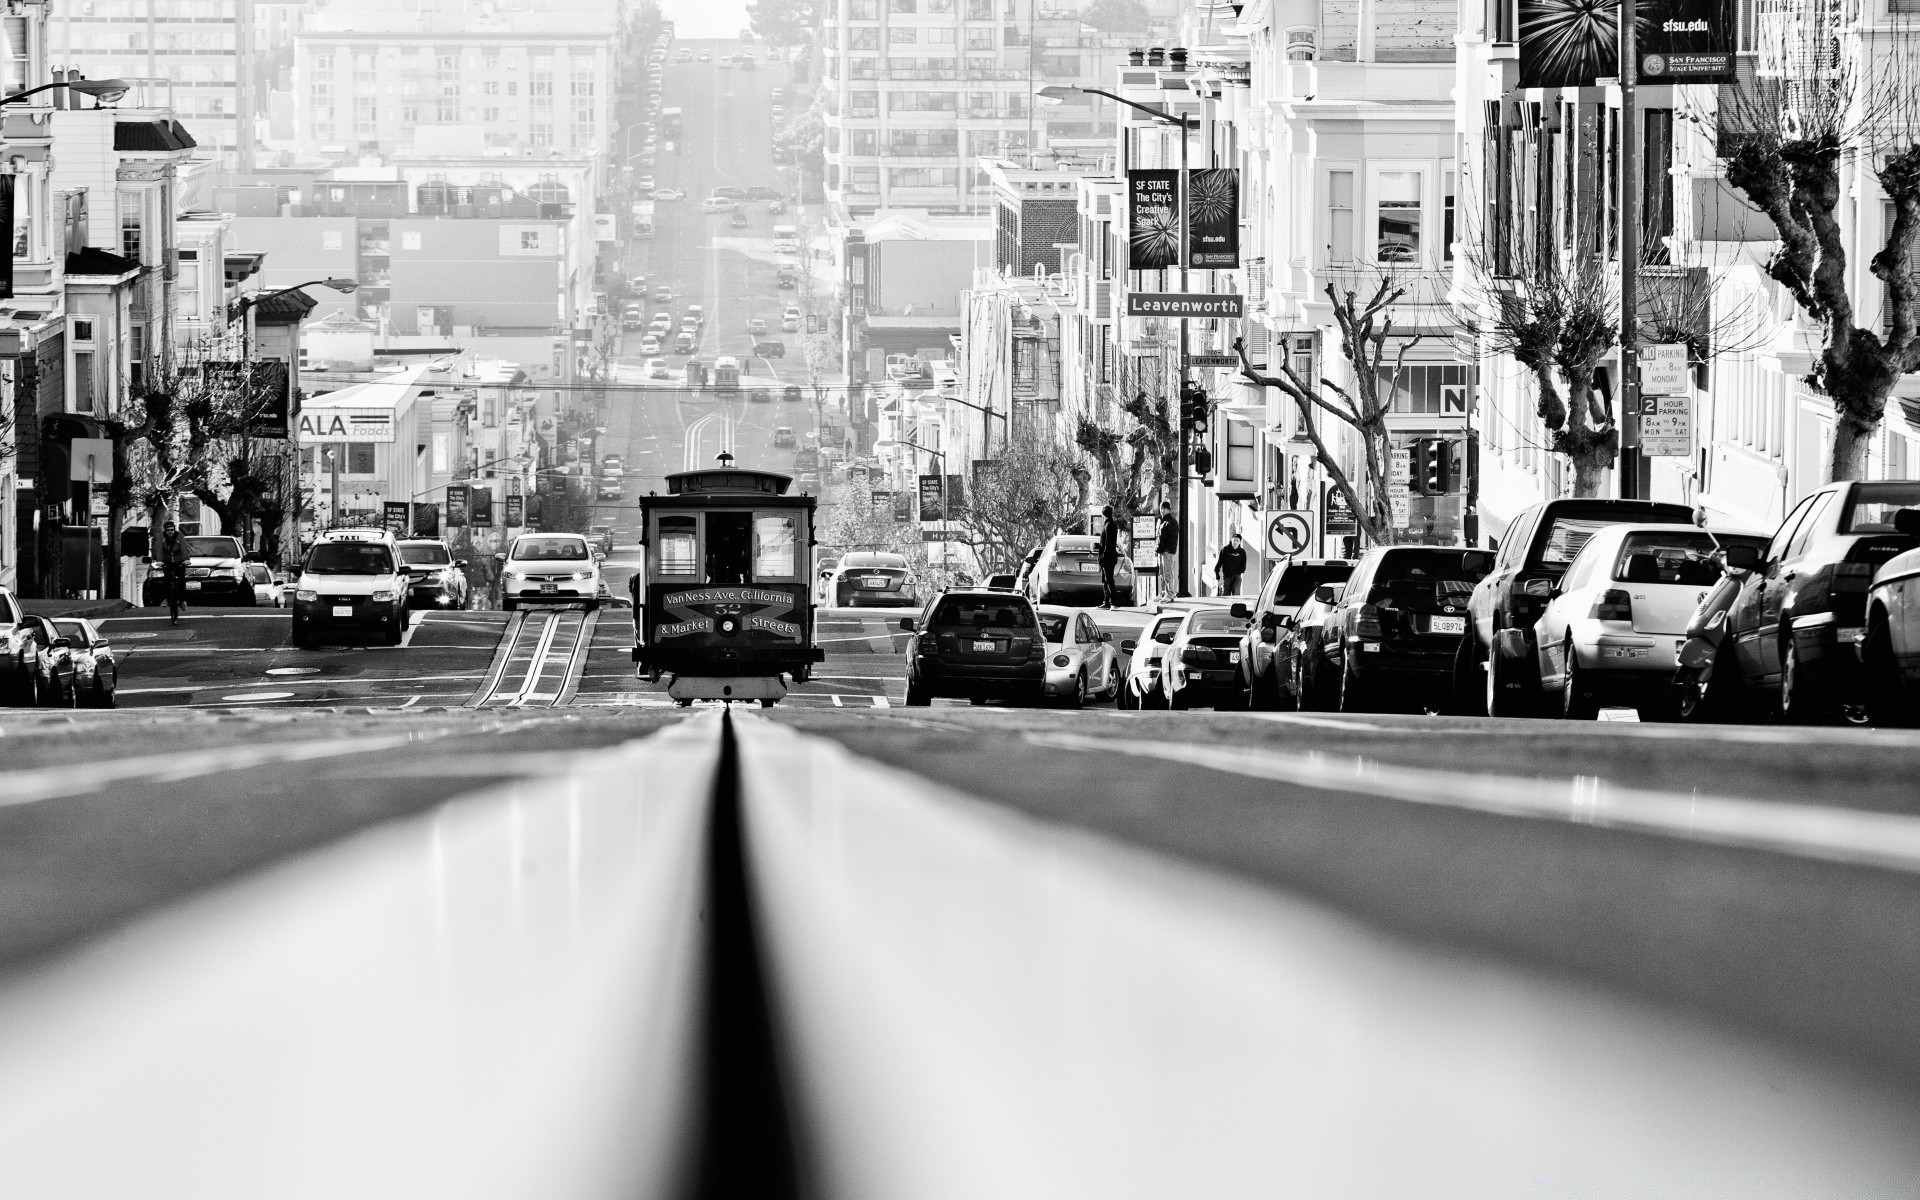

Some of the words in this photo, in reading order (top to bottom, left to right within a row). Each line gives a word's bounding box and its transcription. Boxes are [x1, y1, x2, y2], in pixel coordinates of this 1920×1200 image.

[1662, 18, 1708, 32] sfsu.edu
[1669, 56, 1684, 64] SAN
[1135, 180, 1146, 190] SF
[1147, 180, 1170, 190] STATE
[1136, 192, 1150, 202] The
[1151, 192, 1172, 203] City's
[1136, 204, 1169, 214] Creative
[1202, 235, 1226, 243] sfsu.edu
[1132, 298, 1238, 313] Leavenworth
[1643, 346, 1655, 360] NO
[1657, 349, 1685, 359] PARKING
[1192, 357, 1237, 365] LEAVENWORTH
[1651, 375, 1678, 383] MONDAY
[1644, 399, 1655, 412] 2
[1663, 400, 1684, 408] HOUR
[1658, 408, 1689, 416] PARKING
[300, 415, 347, 436] ALA
[353, 424, 390, 436] Foods
[1644, 428, 1660, 436] MON
[1674, 428, 1688, 436] SAT
[666, 594, 685, 605] Van
[685, 592, 711, 602] Ness
[740, 590, 793, 604] California
[714, 603, 741, 615] 52
[661, 624, 669, 635] &
[670, 619, 709, 634] Market
[751, 617, 795, 634] Streets
